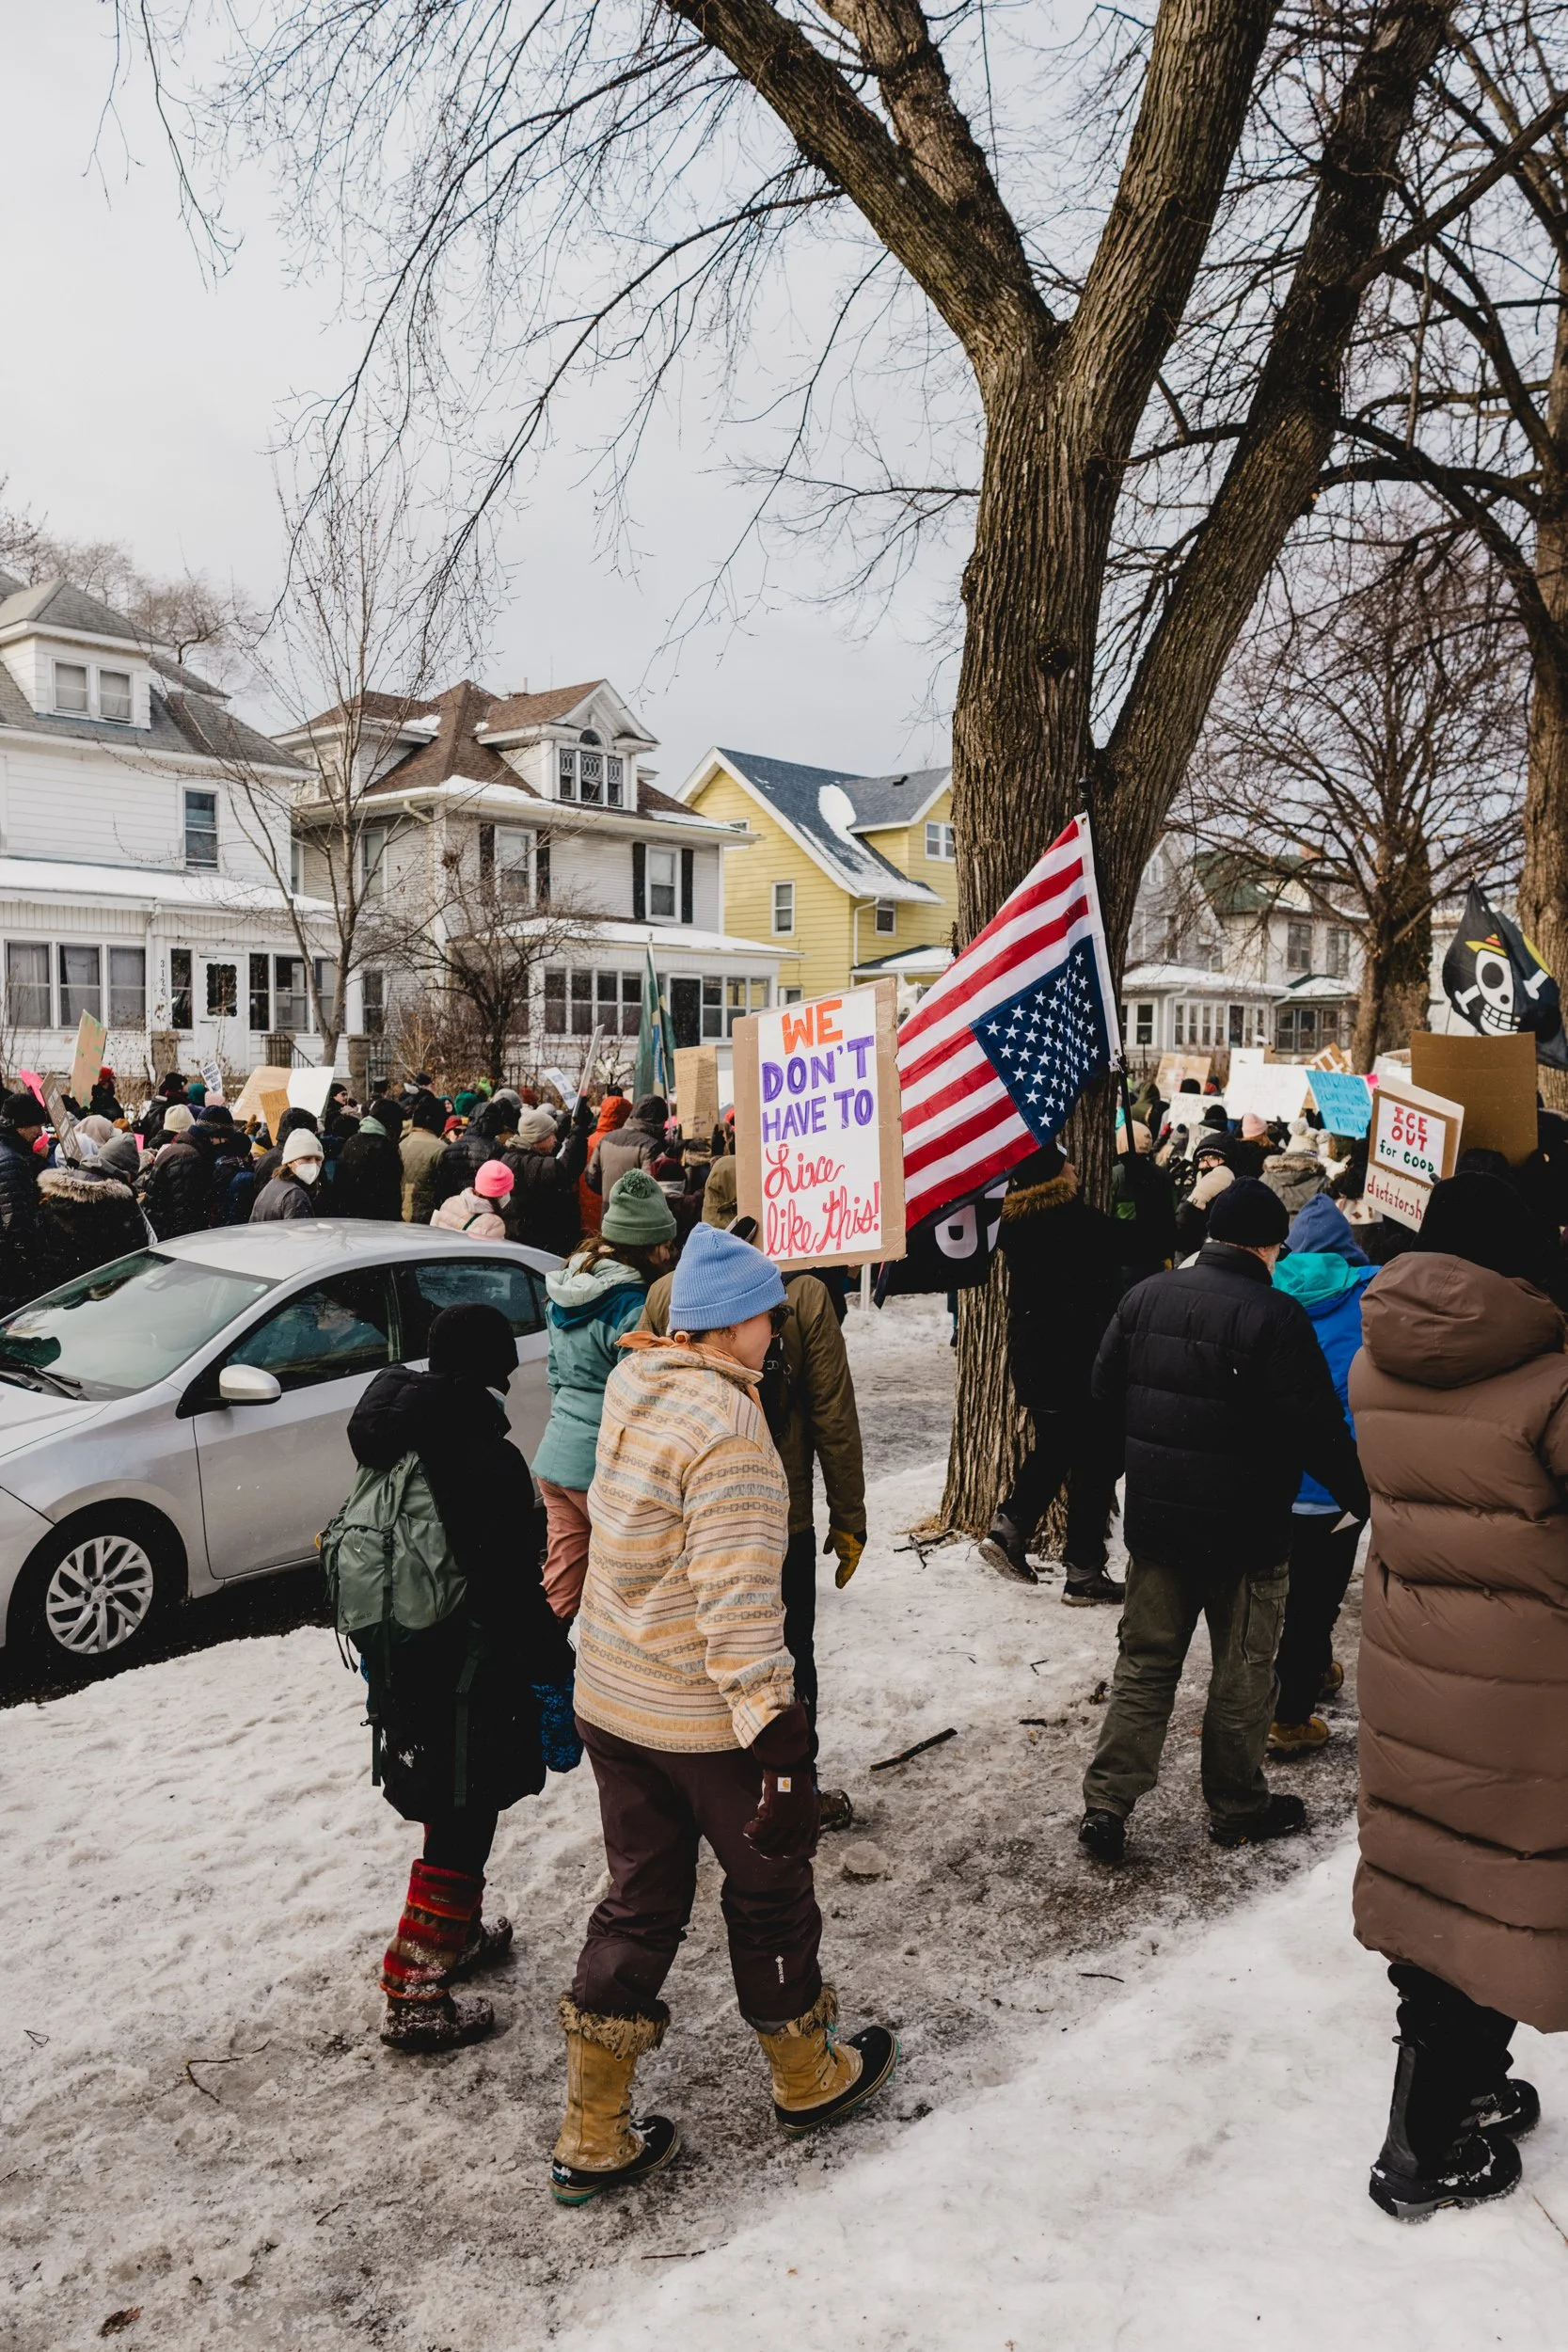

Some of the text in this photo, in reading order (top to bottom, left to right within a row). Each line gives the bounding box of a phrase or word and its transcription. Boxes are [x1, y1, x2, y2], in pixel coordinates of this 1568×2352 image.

[782, 998, 844, 1055] WE
[761, 1035, 875, 1104] DON'T
[762, 1095, 827, 1143] HAVE
[833, 1089, 875, 1130] TO
[1391, 1125, 1428, 1152] OUT
[1394, 1106, 1428, 1135] ICE
[1380, 1139, 1434, 1173] for GOOD
[766, 1197, 816, 1259] like
[816, 1179, 880, 1254] this!
